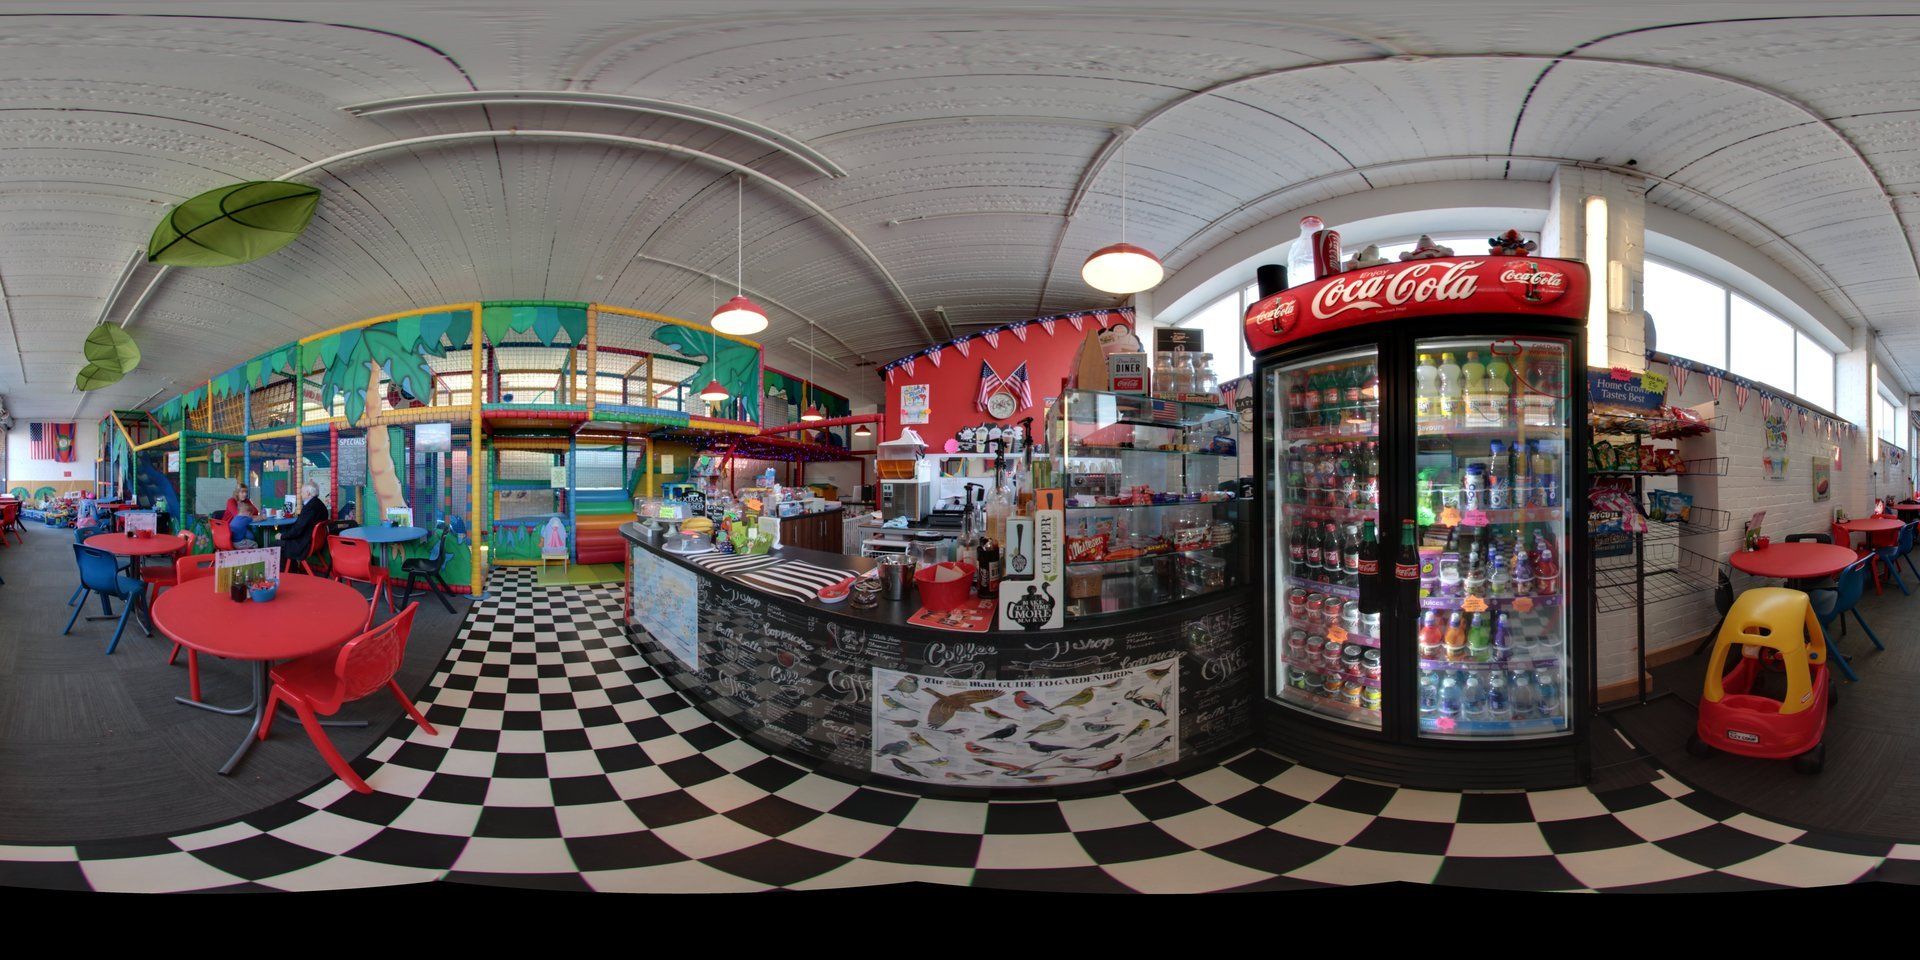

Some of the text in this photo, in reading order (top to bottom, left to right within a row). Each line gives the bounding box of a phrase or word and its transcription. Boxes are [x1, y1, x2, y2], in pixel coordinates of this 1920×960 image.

[1359, 269, 1389, 279] Enjoy
[1500, 269, 1564, 286] Coca-Cola
[1311, 260, 1486, 320] Coca-Cola
[1256, 299, 1297, 325] Coca-Cola
[1116, 363, 1140, 373] DINER
[1597, 379, 1622, 390] Home
[1602, 389, 1645, 402] Tastes Best
[339, 438, 366, 446] SPECIALS
[1041, 517, 1051, 574] CLIPPER
[1015, 609, 1051, 619] MORE
[923, 640, 999, 668] Coffee
[998, 680, 1037, 688] GUIDE
[1055, 675, 1101, 686] GARDEN
[1102, 670, 1134, 680] BIRDS
